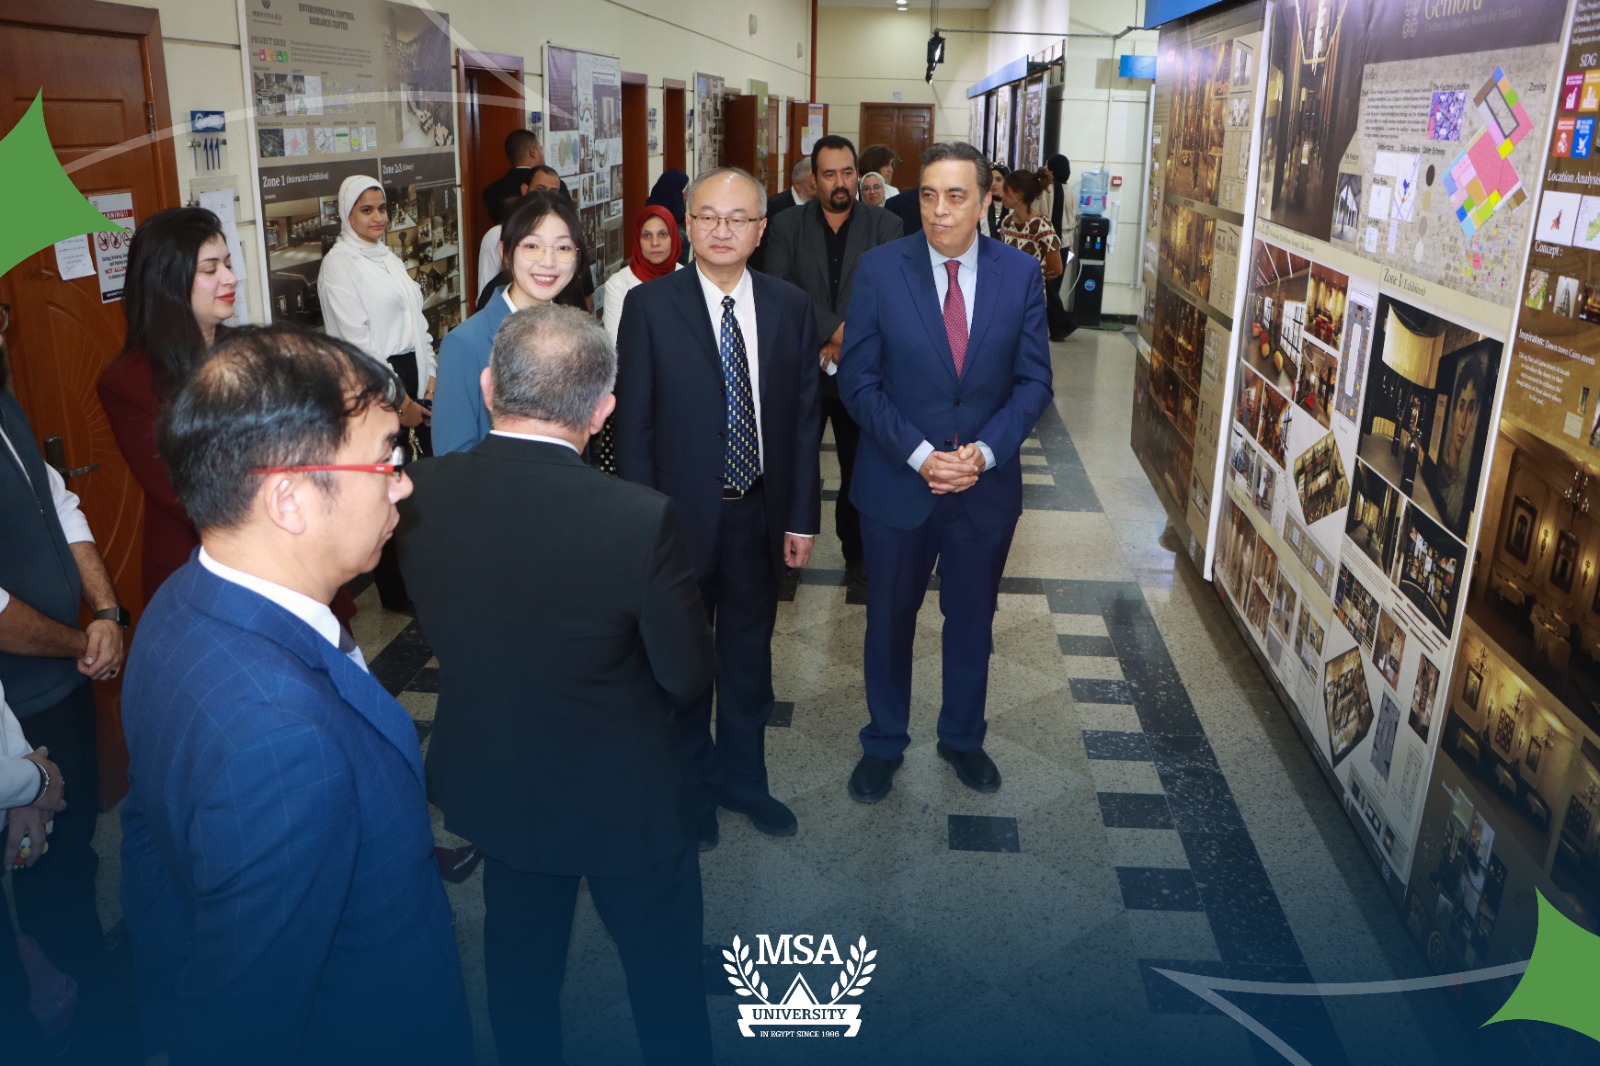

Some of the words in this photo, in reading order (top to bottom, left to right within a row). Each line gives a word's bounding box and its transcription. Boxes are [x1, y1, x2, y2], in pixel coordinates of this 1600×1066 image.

[298, 3, 335, 17] ENVIRONMENTAL
[335, 9, 355, 20] CONTROL
[309, 16, 332, 27] RESEARCH
[332, 20, 348, 30] CENTER
[251, 35, 272, 46] PROJECT
[1580, 53, 1598, 67] SDG
[1529, 81, 1547, 94] Zoning
[382, 164, 394, 175] Zone
[1547, 169, 1574, 183] Location
[262, 176, 280, 188] Zone
[281, 174, 286, 186] 1
[1535, 241, 1560, 259] Concept
[1383, 267, 1397, 286] Zone
